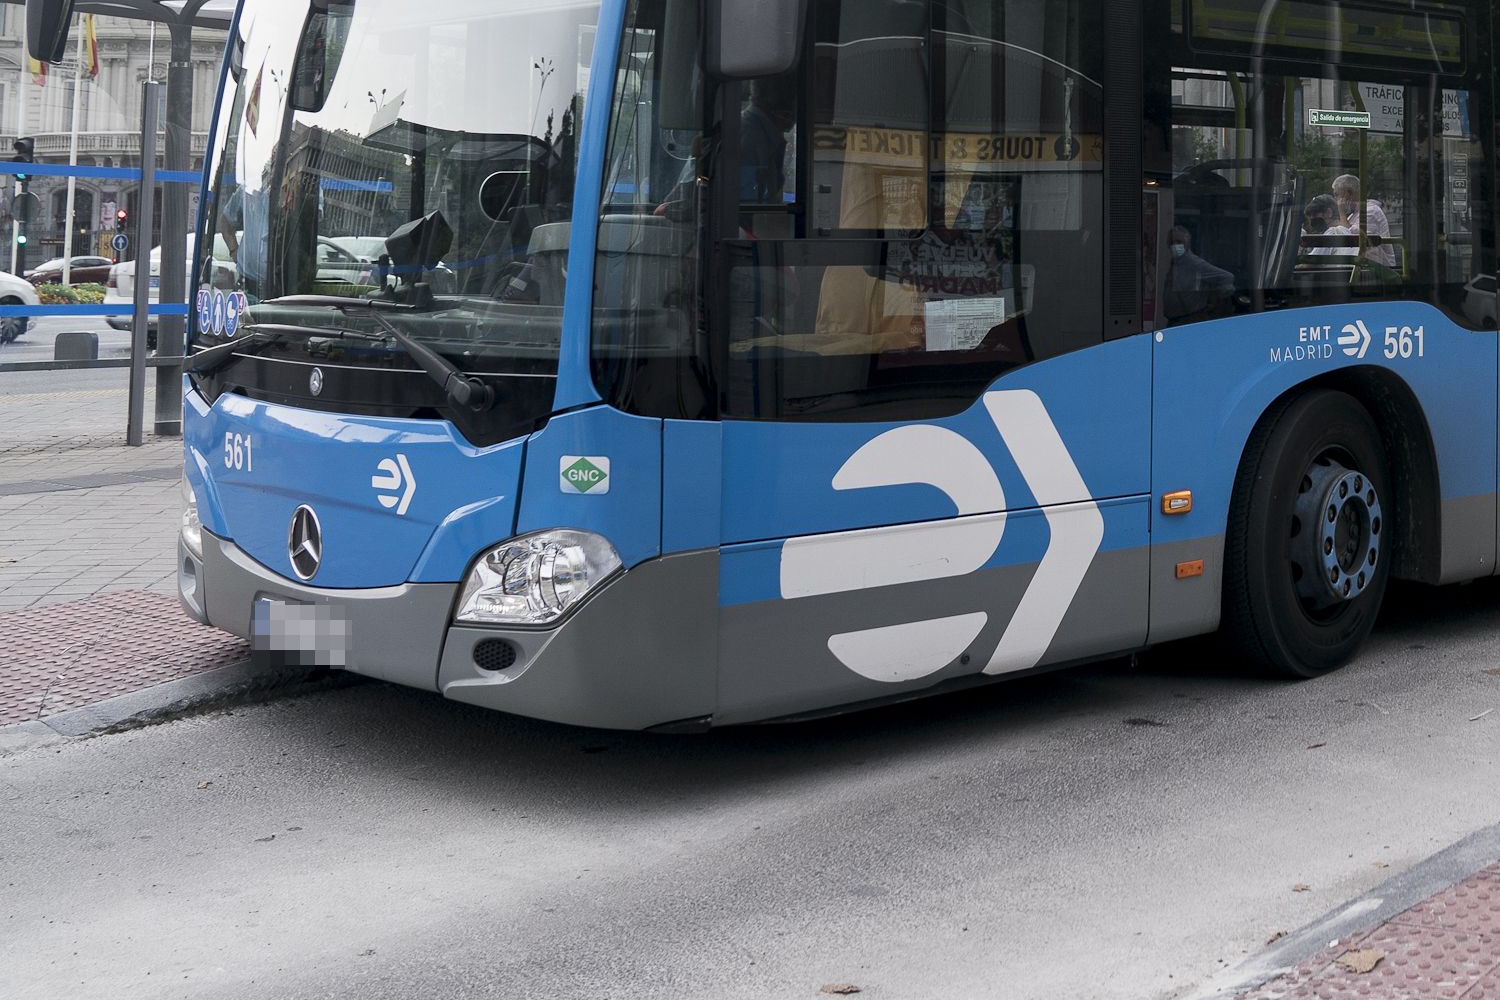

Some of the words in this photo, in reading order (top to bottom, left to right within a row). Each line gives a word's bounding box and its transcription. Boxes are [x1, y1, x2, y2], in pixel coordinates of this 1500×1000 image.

[1319, 113, 1334, 122] Salida
[1335, 114, 1341, 122] de
[1342, 115, 1369, 125] emergencia
[1300, 325, 1331, 342] EMT
[1383, 325, 1424, 359] 561
[1270, 343, 1333, 363] MADRID
[224, 431, 252, 472] 561
[568, 469, 599, 482] GNC
